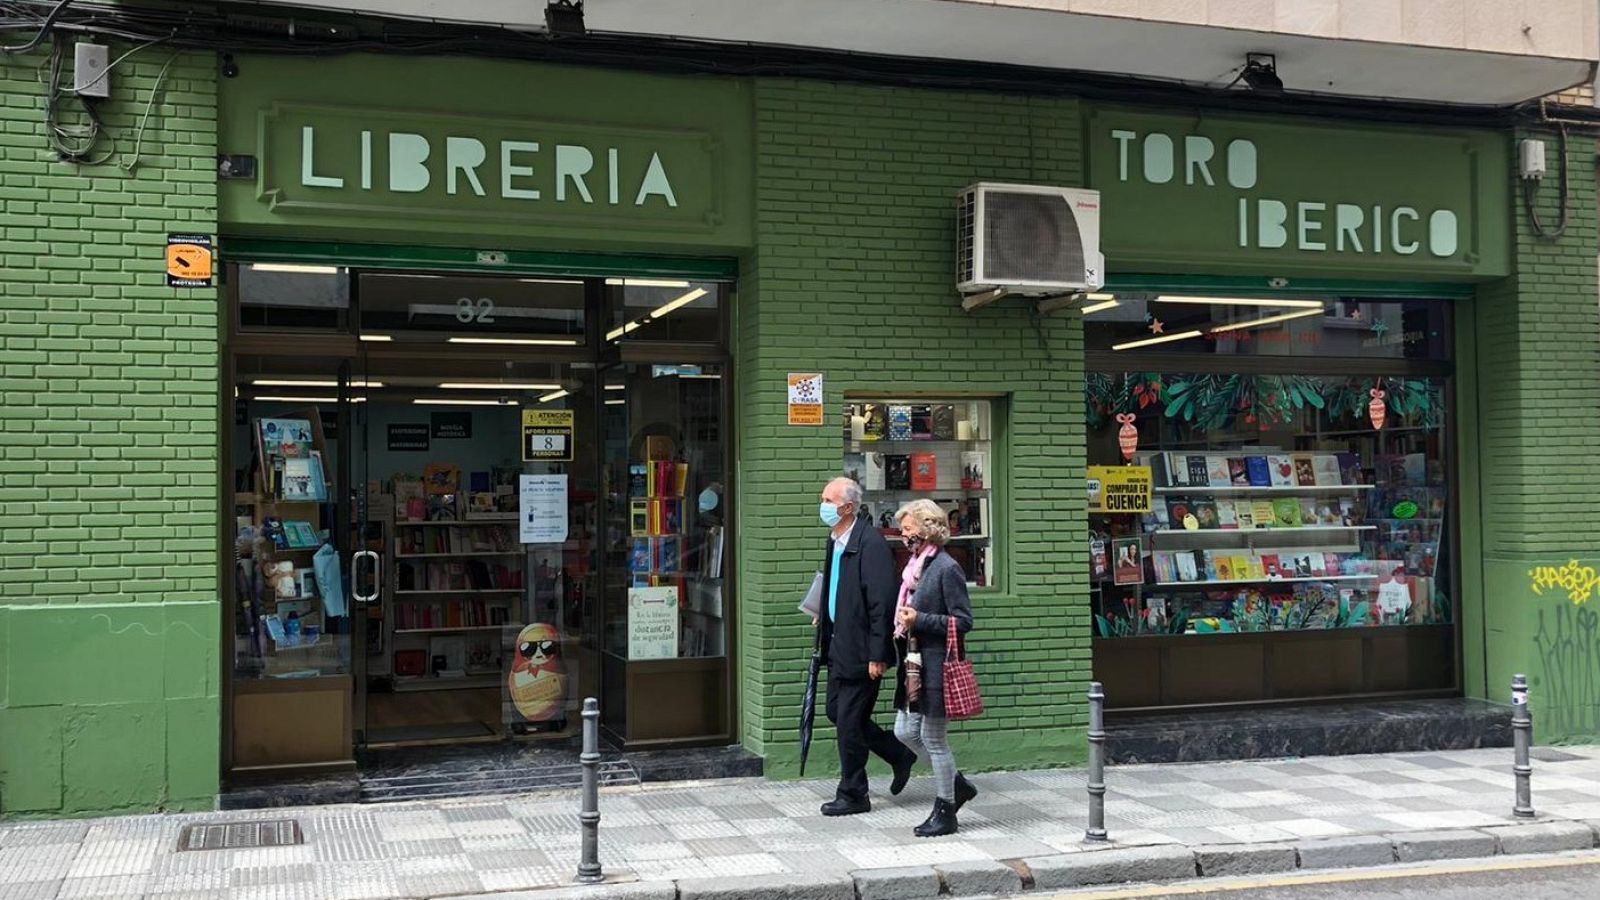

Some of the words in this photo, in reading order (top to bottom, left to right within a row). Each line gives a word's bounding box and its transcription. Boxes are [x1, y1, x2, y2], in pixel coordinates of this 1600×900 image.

[302, 126, 677, 207] LIBRERIA
[1111, 130, 1257, 189] TORO
[1239, 198, 1458, 256] IBERICO
[456, 297, 495, 323] 82
[544, 436, 553, 450] 8
[1106, 484, 1138, 494] COMPRAR
[1140, 484, 1148, 494] EN
[1106, 494, 1148, 510] CUENCA
